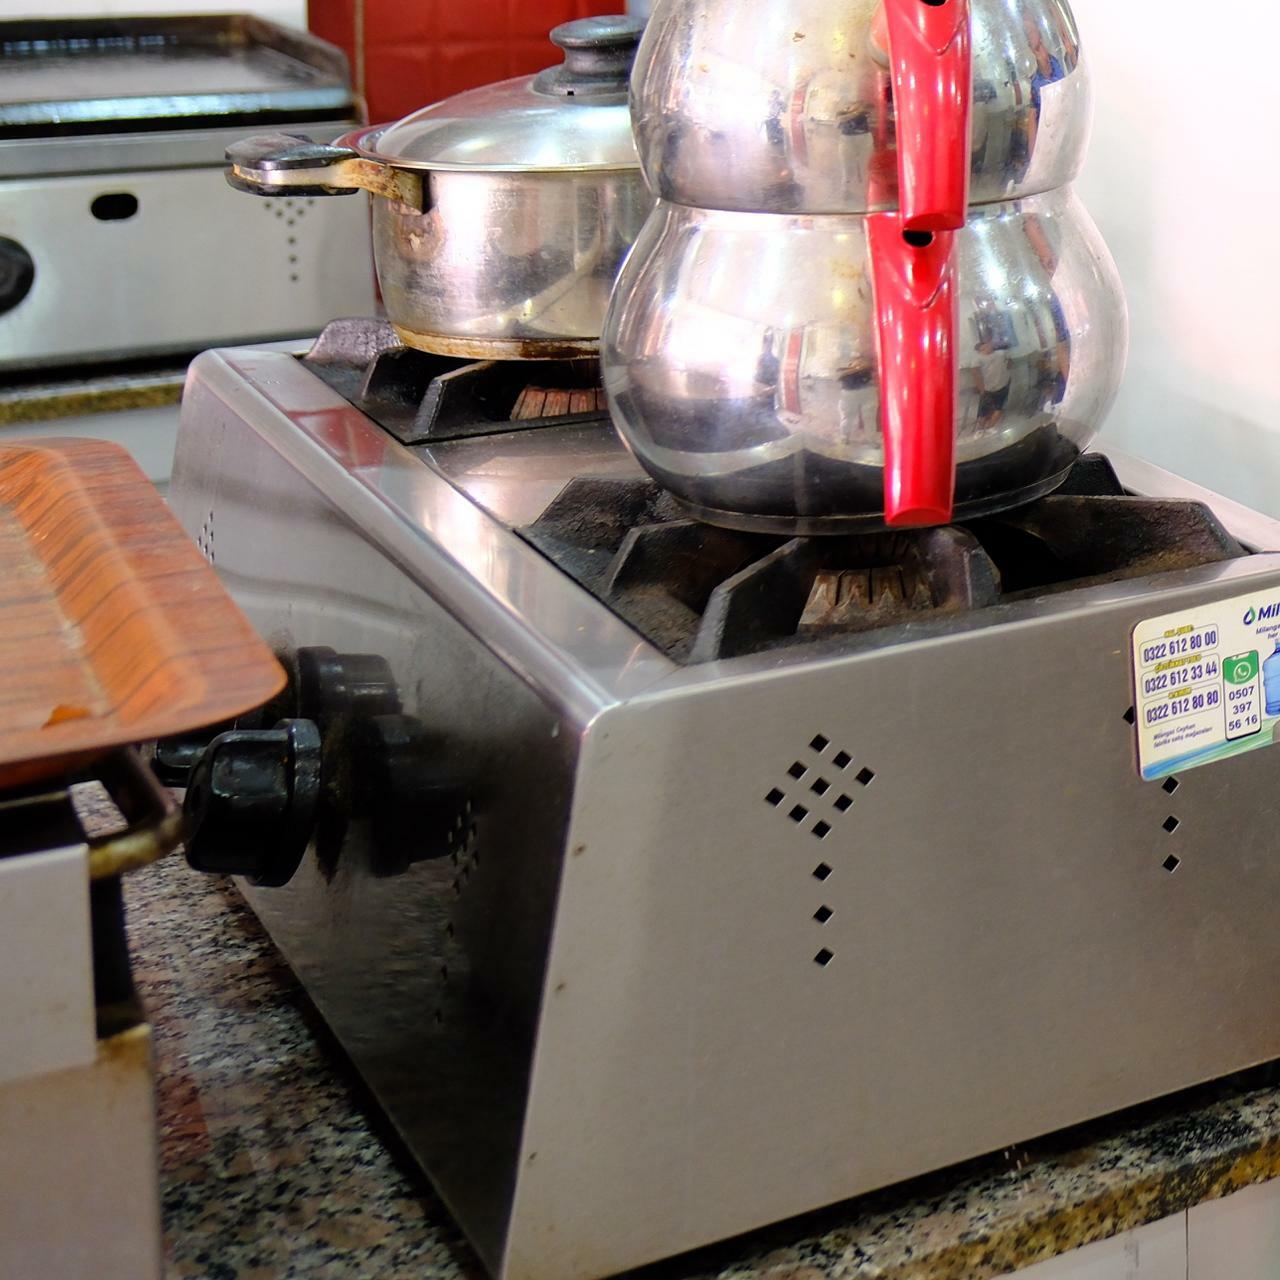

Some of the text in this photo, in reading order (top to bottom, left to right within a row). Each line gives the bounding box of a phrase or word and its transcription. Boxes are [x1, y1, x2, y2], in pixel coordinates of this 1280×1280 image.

[1143, 643, 1167, 662] 0322
[1169, 638, 1187, 655] 612
[1190, 634, 1202, 649] 80
[1204, 630, 1217, 646] 00
[1145, 674, 1167, 693] 0322
[1170, 669, 1188, 686] 612
[1191, 664, 1203, 681] 33
[1205, 661, 1218, 676] 44
[1228, 685, 1255, 701] 0507
[1146, 703, 1169, 723] 0322
[1171, 698, 1190, 716] 612
[1192, 694, 1204, 710] 80
[1206, 690, 1219, 705] 80
[1232, 701, 1253, 715] 397
[1228, 714, 1258, 731] 56 16
